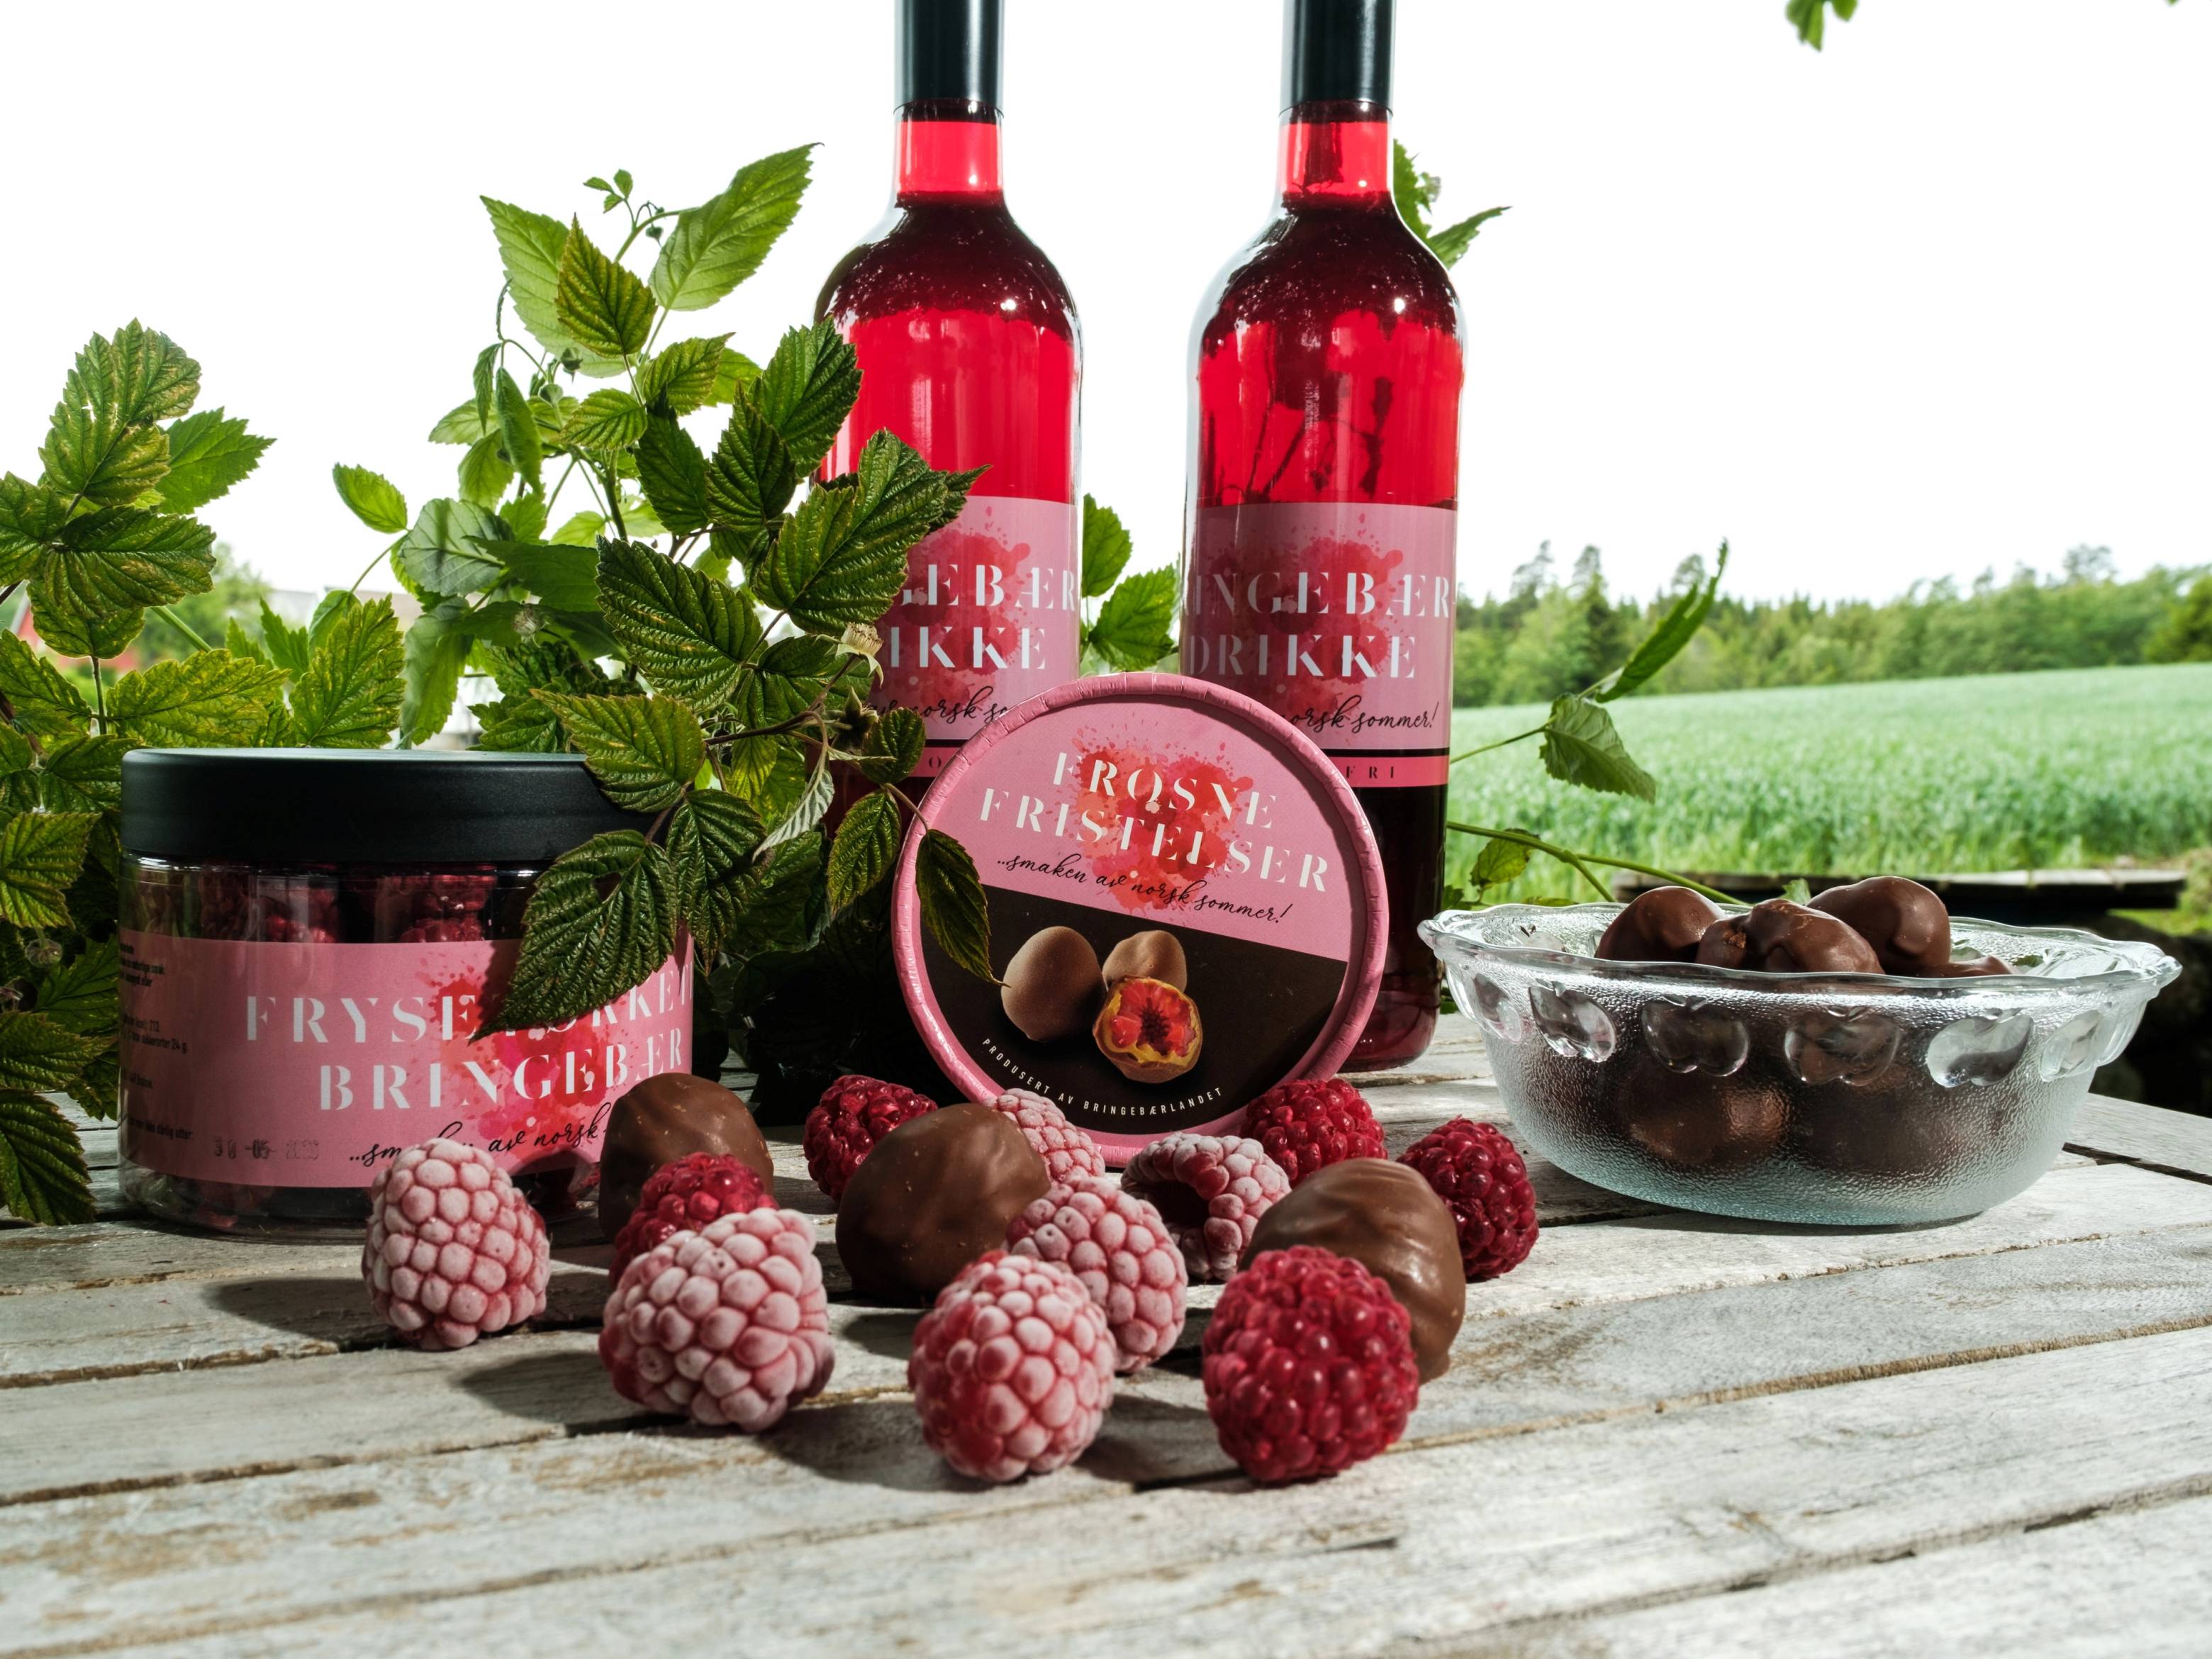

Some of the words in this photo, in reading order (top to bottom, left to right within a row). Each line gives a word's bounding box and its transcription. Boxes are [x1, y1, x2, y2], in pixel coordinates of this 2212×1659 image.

[899, 562, 1076, 612] EBÆR
[1185, 571, 1450, 618] INGEBÆR
[1190, 635, 1416, 678] DRIKKE
[1281, 694, 1363, 733] orsk
[1350, 701, 1440, 734] sommer!
[1053, 752, 1277, 829] FROSNE
[980, 788, 1328, 893] FRISTELSER
[1131, 879, 1207, 905] norsk
[1194, 894, 1294, 924] sommer!
[320, 1027, 682, 1111] BRINGEBÆR
[982, 1038, 1050, 1095] PRODUSERT
[1058, 1093, 1073, 1105] AV
[1083, 1087, 1222, 1116] BRINGEBÆRLANDET
[534, 1102, 612, 1149] norsk
